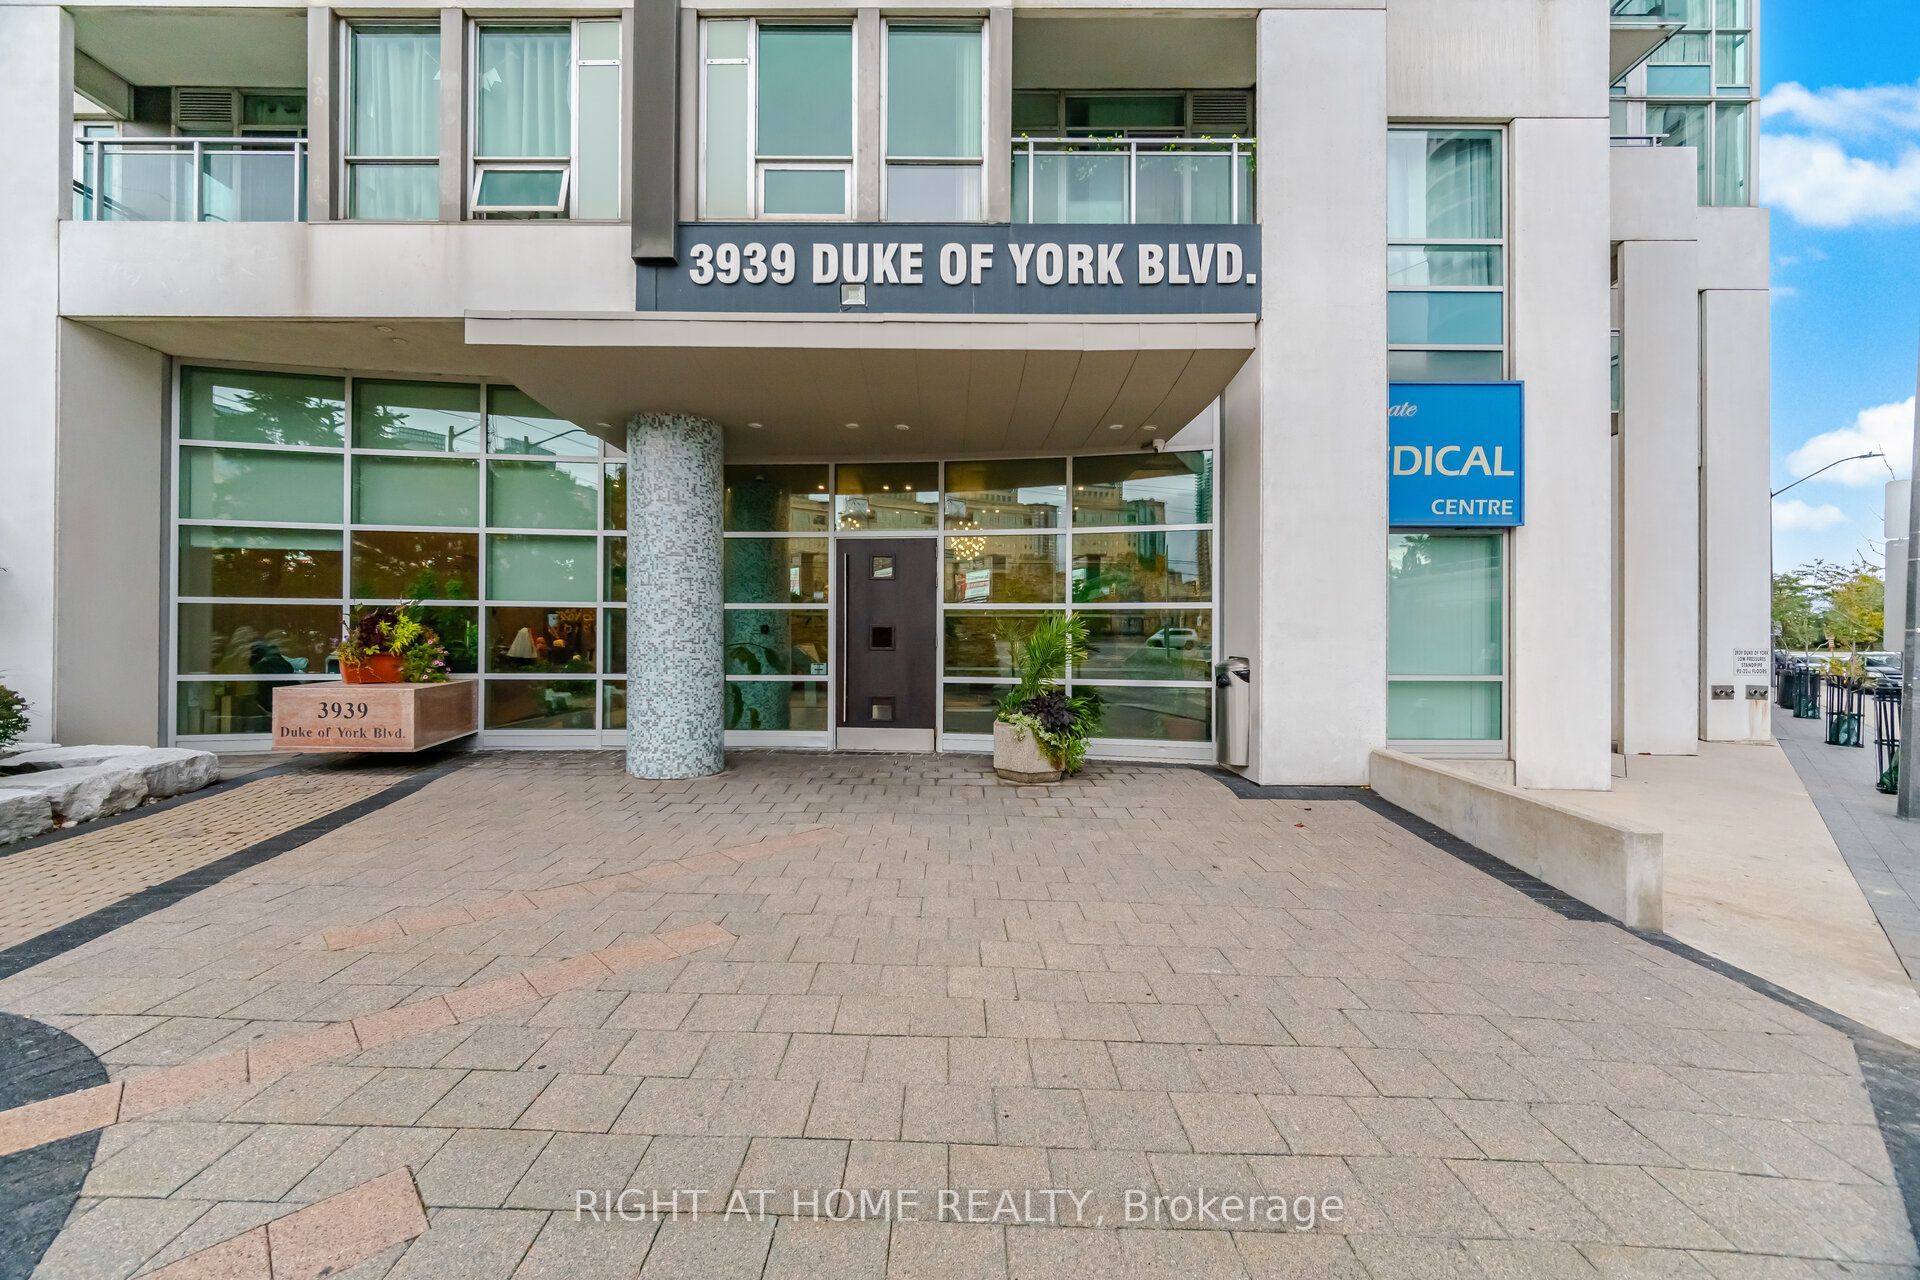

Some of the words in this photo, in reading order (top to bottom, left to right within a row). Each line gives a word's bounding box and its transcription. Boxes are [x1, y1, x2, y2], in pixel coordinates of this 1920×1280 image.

[689, 242, 796, 286] 3939
[812, 242, 924, 285] DUKE
[940, 242, 994, 286] OF
[1008, 242, 1125, 286] YORK
[1137, 242, 1257, 286] BLVD.
[1389, 445, 1515, 477] DICAL
[1431, 499, 1514, 516] CENTRE
[317, 702, 368, 719] 3939
[280, 726, 312, 738] Duke
[317, 727, 331, 738] of
[337, 727, 367, 739] York
[373, 727, 406, 739] Blvd.
